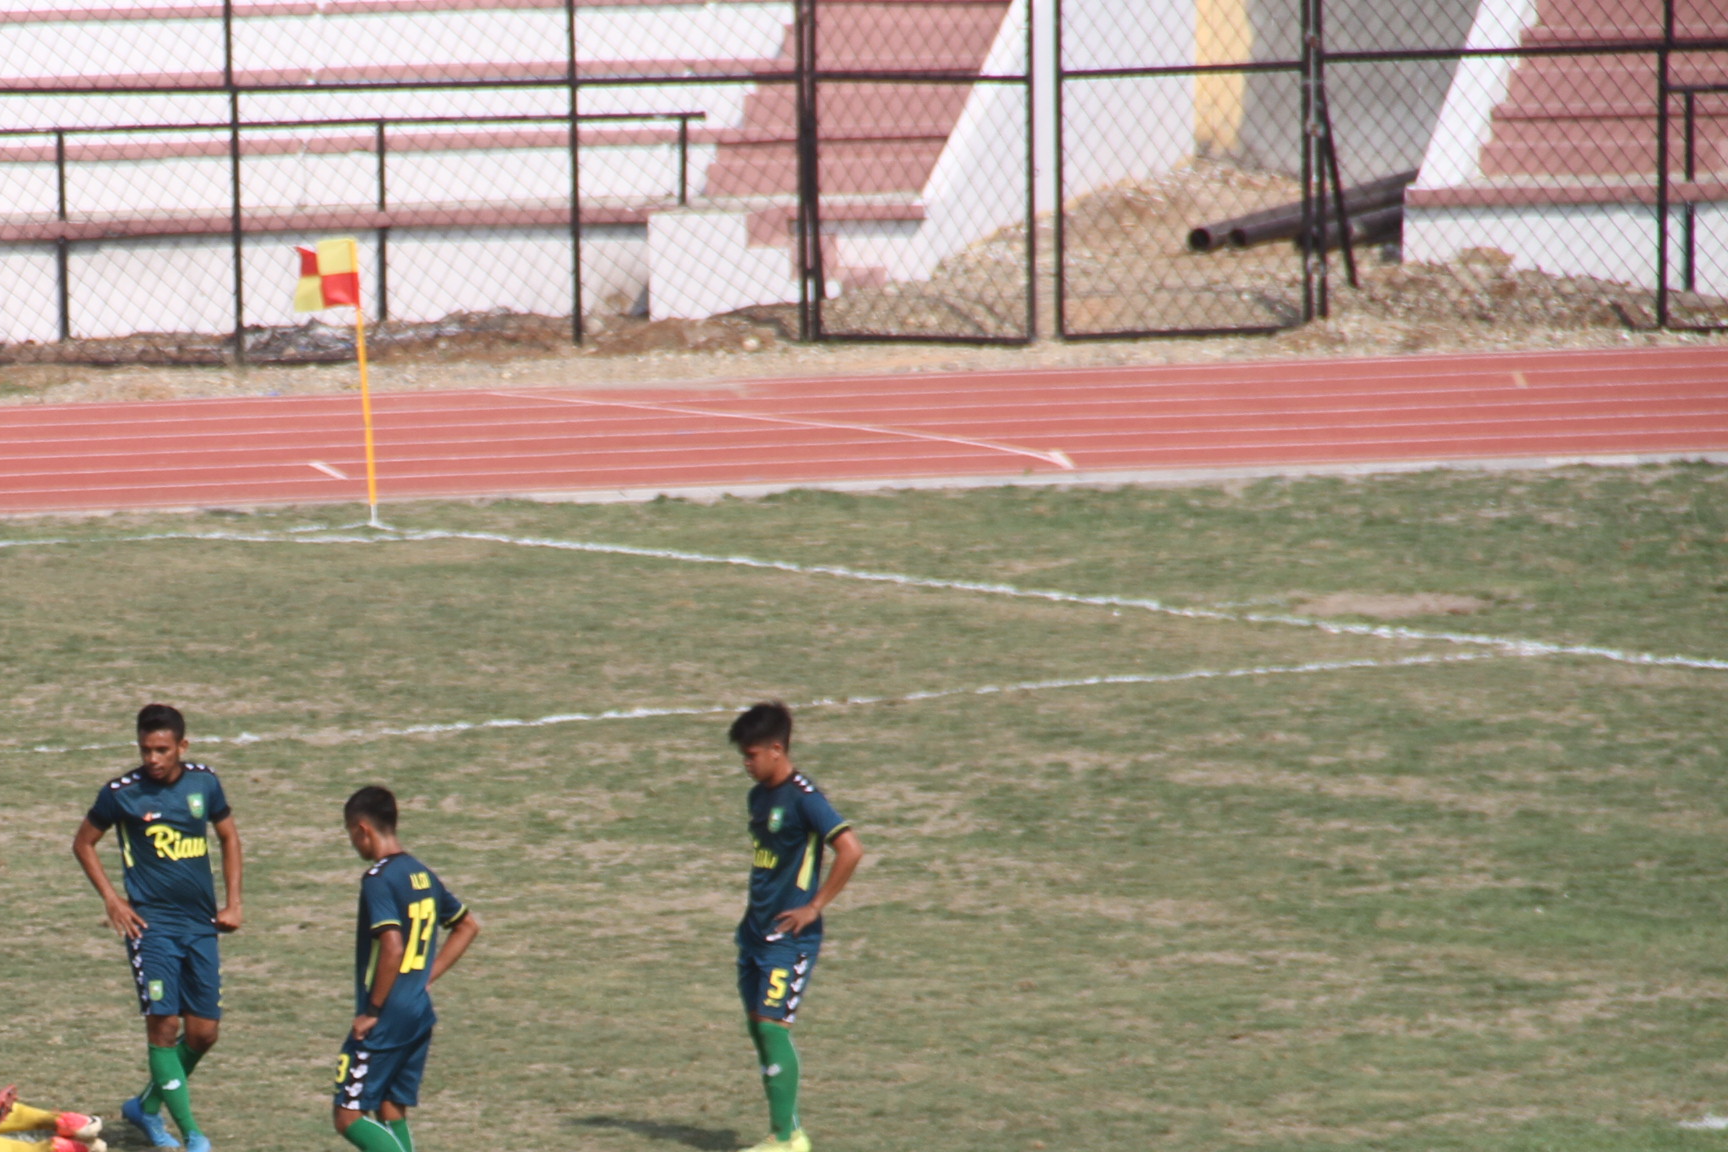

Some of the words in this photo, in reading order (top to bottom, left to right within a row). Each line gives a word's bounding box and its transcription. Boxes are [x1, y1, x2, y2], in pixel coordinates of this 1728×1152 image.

[145, 824, 207, 861] Riau
[753, 841, 778, 869] iau
[399, 897, 436, 973] 13
[767, 968, 789, 1000] 5
